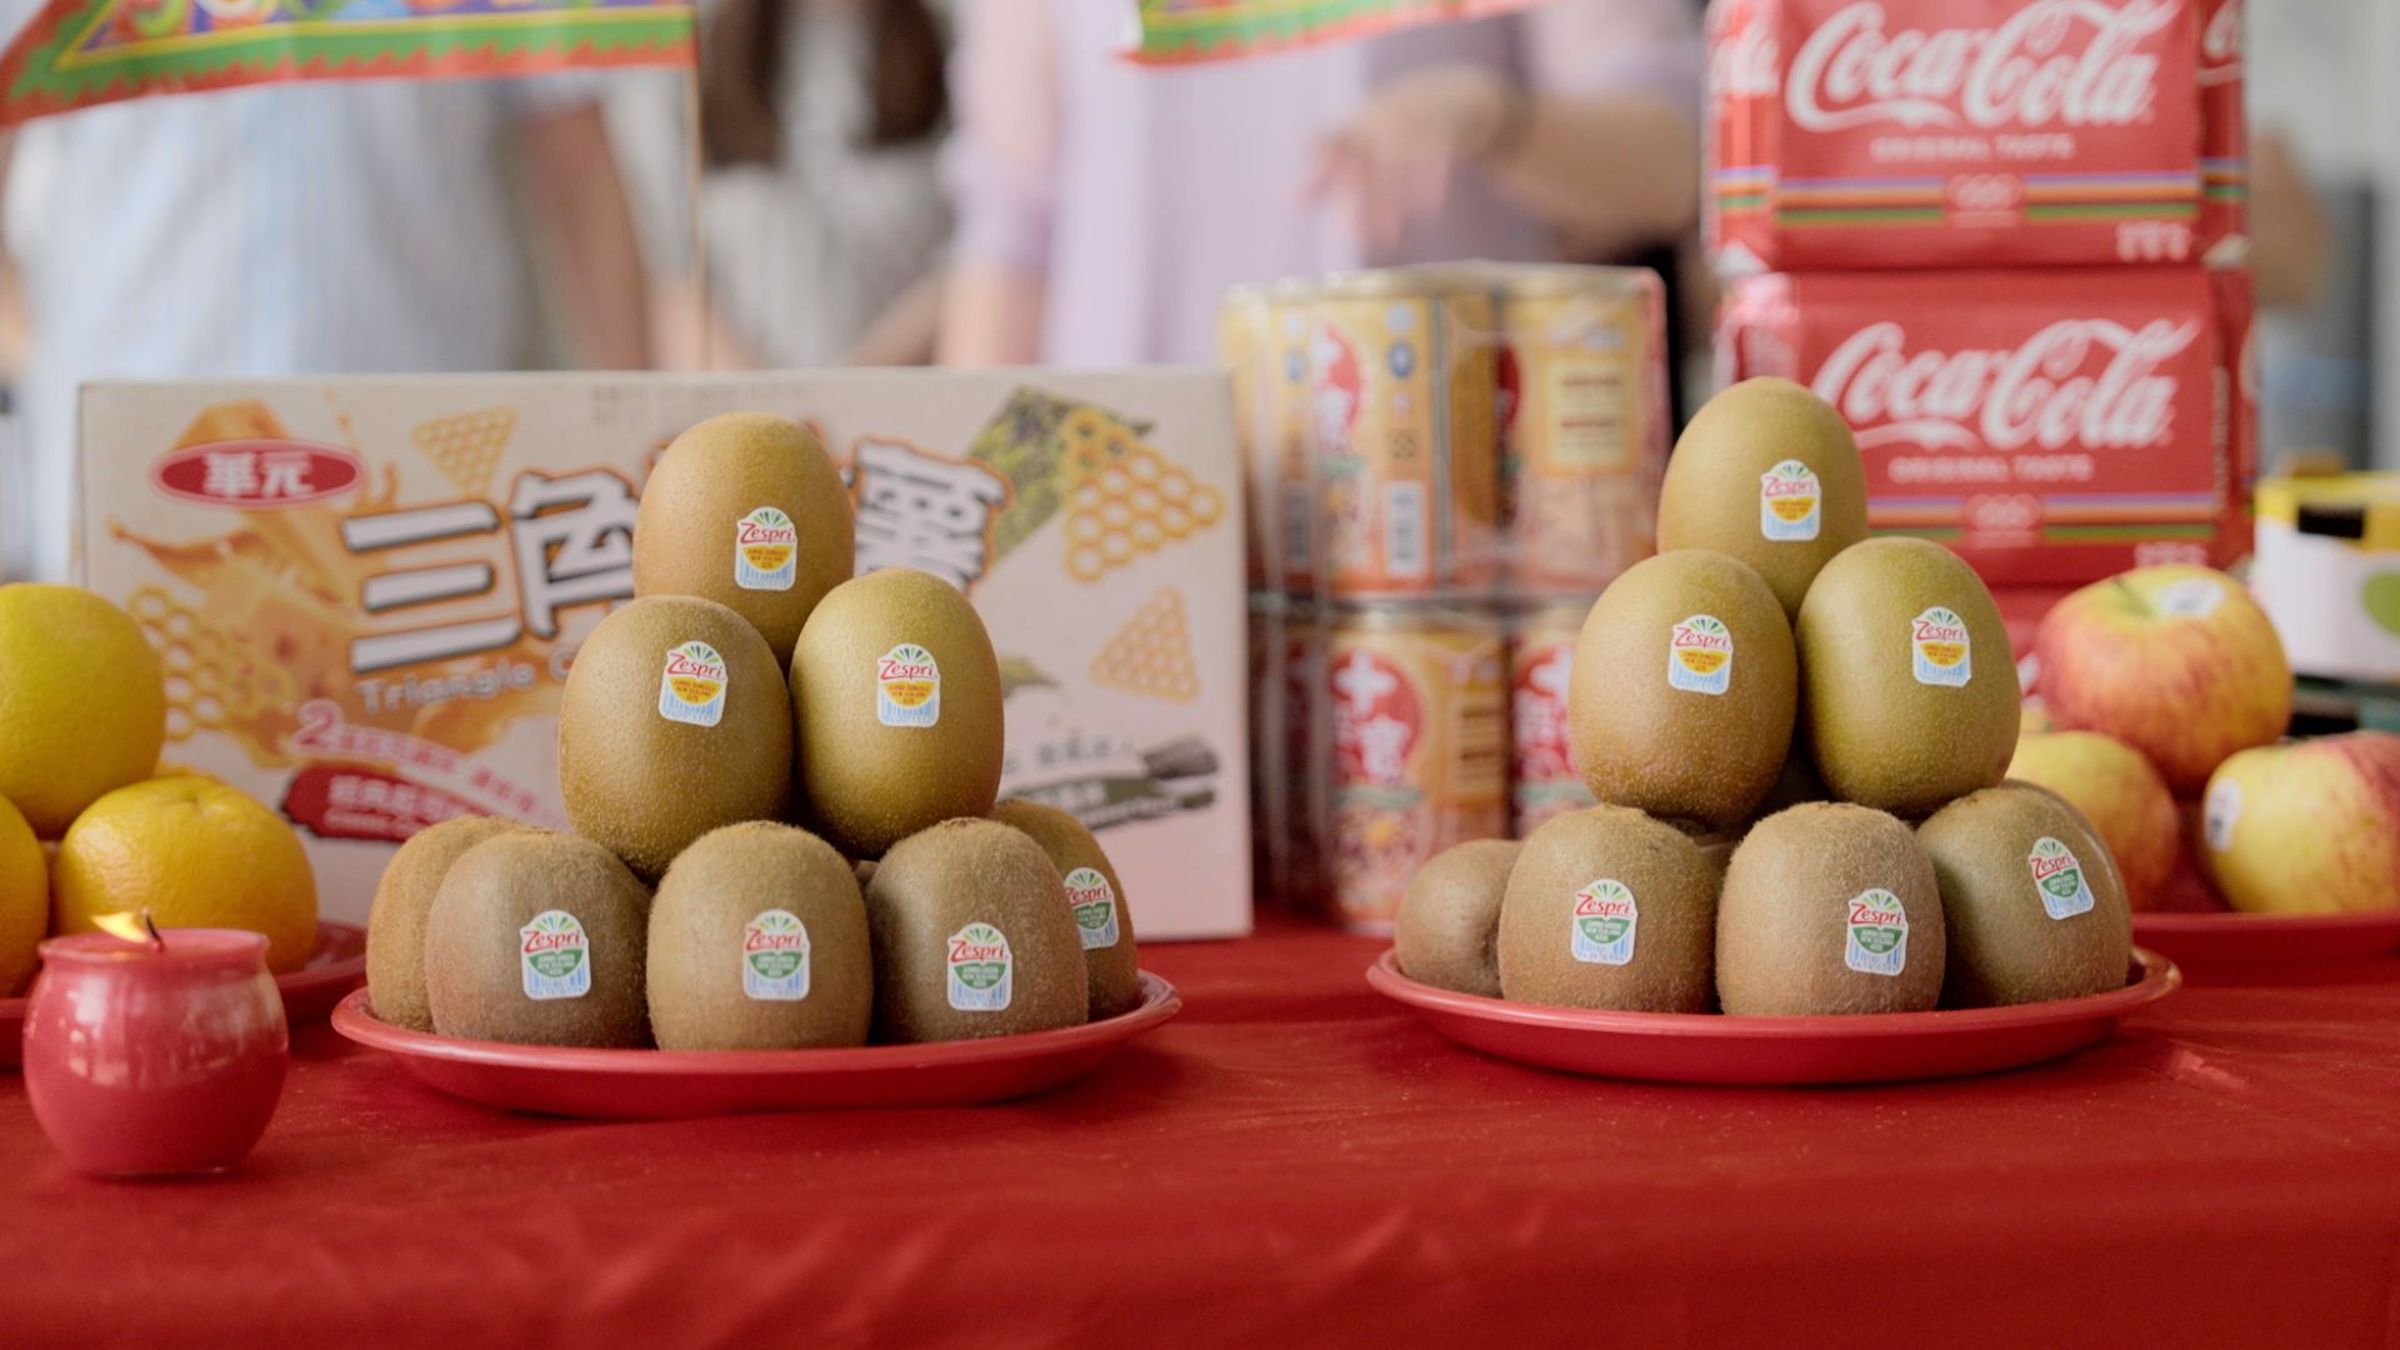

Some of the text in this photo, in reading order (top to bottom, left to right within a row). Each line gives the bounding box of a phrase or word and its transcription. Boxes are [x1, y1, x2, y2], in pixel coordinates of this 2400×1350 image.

[1786, 0, 2185, 131] Coca-Cola
[740, 522, 792, 545] Zespri
[1675, 626, 1728, 648] Zespri
[1915, 620, 1963, 641] Zespri
[667, 652, 722, 678] Zespri
[880, 660, 934, 681] Zespri
[355, 657, 536, 714] Triangle
[2031, 852, 2073, 879] Zespri
[1576, 893, 1631, 917] Zespri
[1850, 902, 1902, 926] Zespri
[523, 929, 580, 953] Zespri
[746, 928, 801, 951] Zespri
[951, 940, 1005, 962] Zespri
